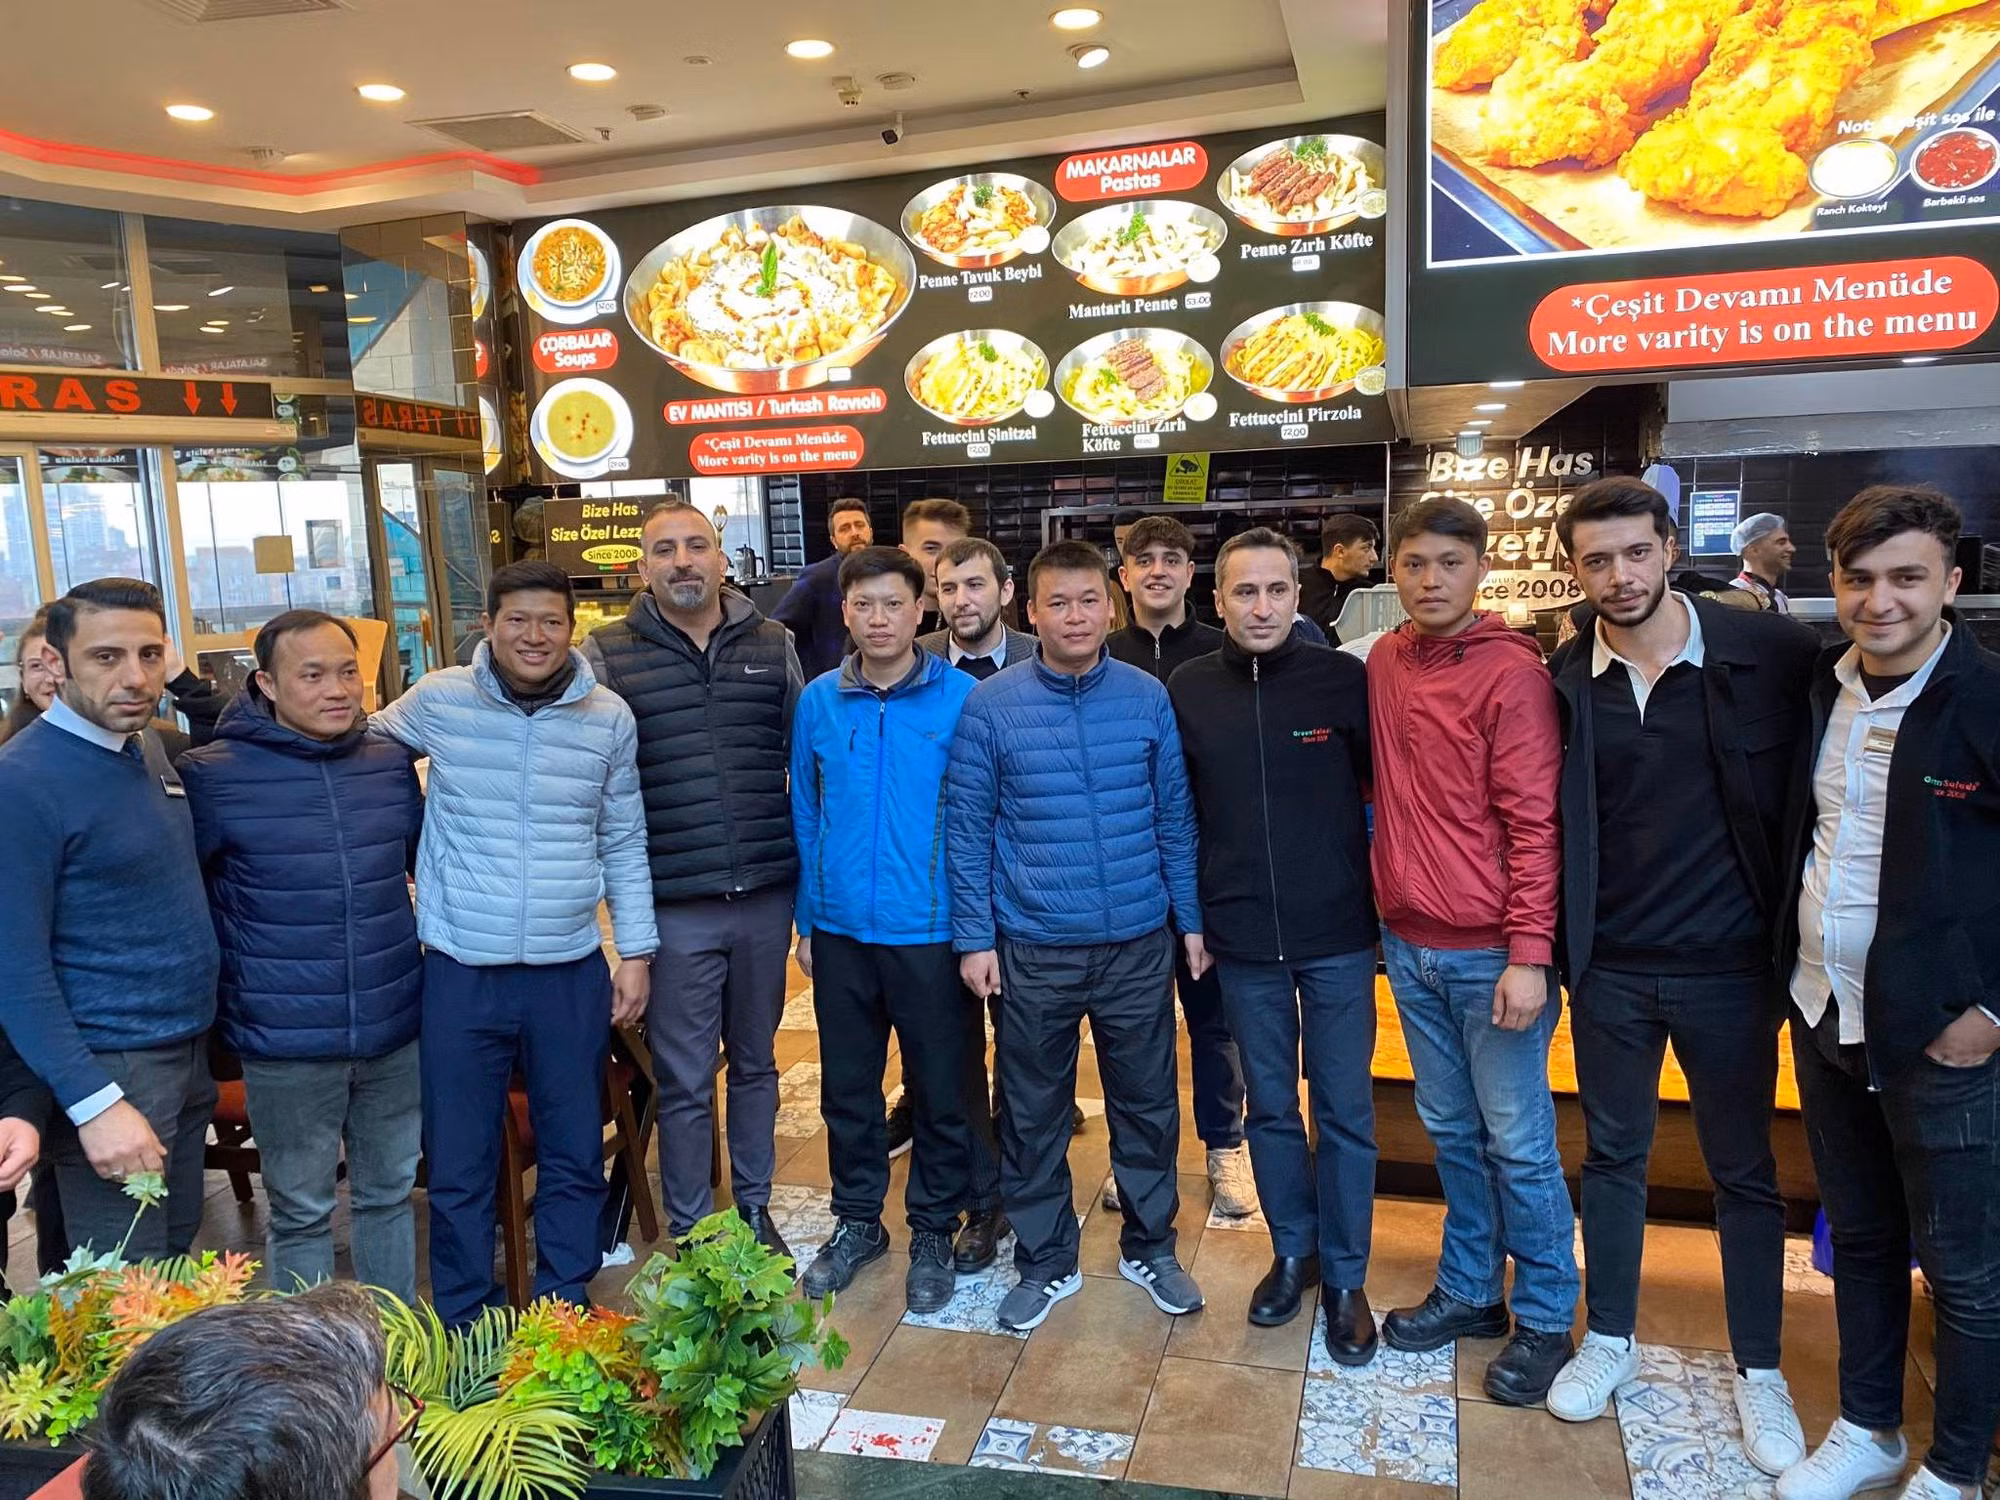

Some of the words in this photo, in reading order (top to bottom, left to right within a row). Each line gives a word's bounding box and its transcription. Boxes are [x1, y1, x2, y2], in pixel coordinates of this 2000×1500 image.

[1975, 106, 1996, 122] ile
[1066, 146, 1196, 179] MAKARNALAR
[1100, 172, 1162, 193] Pastas
[1817, 206, 1846, 216] Ranch
[1848, 202, 1888, 214] Kokteyl
[1923, 196, 1966, 208] Barbekü
[1968, 195, 1985, 204] sos
[1240, 244, 1286, 258] Penne
[1330, 232, 1374, 250] Köfte
[919, 274, 958, 289] Penne
[960, 268, 1002, 285] Tavuk
[1674, 286, 1802, 312] Devamı
[1812, 268, 1953, 303] Menüde
[1134, 298, 1178, 312] Penne
[540, 332, 612, 356] ÇORBALAR
[1547, 330, 1628, 356] More
[1637, 322, 1729, 352] varity
[1739, 320, 1763, 344] is
[1774, 320, 1812, 342] on
[1823, 312, 1874, 338] the
[1884, 311, 1978, 335] menu
[554, 352, 596, 368] Soups
[670, 405, 688, 421] EV
[756, 400, 765, 416] /
[1229, 408, 1303, 427] Fettuccini
[1308, 405, 1362, 422] Pirzola
[796, 432, 848, 445] Menüde
[922, 429, 986, 446] Fettuccini
[988, 425, 1036, 444] Şinitzel
[1082, 420, 1150, 437] Fettuccini
[1082, 437, 1120, 452] Köfte
[698, 454, 728, 468] More
[732, 452, 766, 468] varity
[770, 452, 780, 464] is
[782, 454, 798, 464] on
[800, 450, 820, 462] the
[823, 450, 858, 461] menu
[1429, 451, 1510, 482] Bize
[1518, 446, 1594, 478] Has
[582, 504, 610, 518] Bize
[612, 502, 638, 516] Has
[1505, 480, 1575, 520] Öze
[551, 528, 578, 542] Size
[580, 524, 610, 540] Özel
[612, 526, 642, 539] Lezz
[588, 550, 612, 560] Since
[614, 548, 638, 558] 2008
[1516, 578, 1581, 599] 2008
